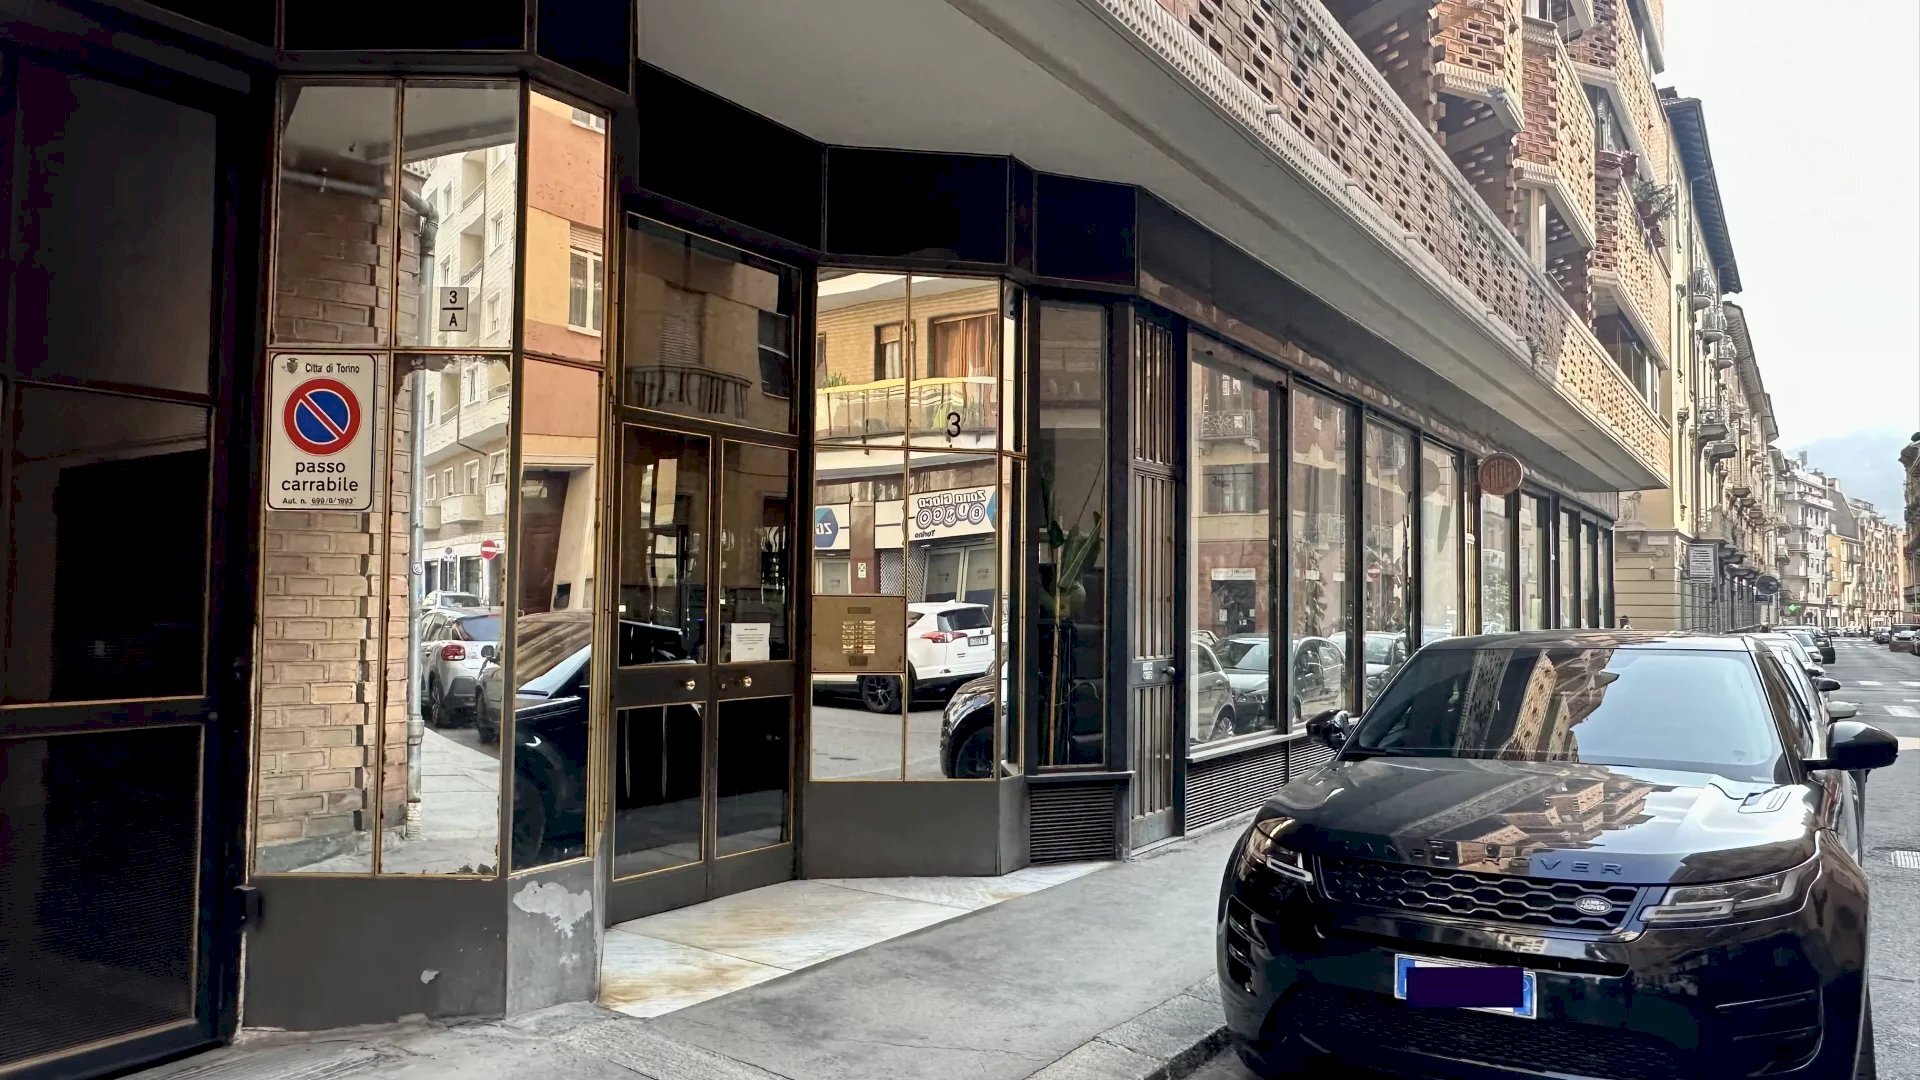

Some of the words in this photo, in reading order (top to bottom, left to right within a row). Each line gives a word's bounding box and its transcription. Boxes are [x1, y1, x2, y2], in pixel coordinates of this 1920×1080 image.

[449, 290, 458, 304] 3
[449, 312, 458, 327] A
[326, 363, 334, 373] di
[336, 363, 360, 374] Torino
[946, 411, 961, 438] 3
[295, 461, 346, 476] passo
[281, 476, 359, 491] carrabile
